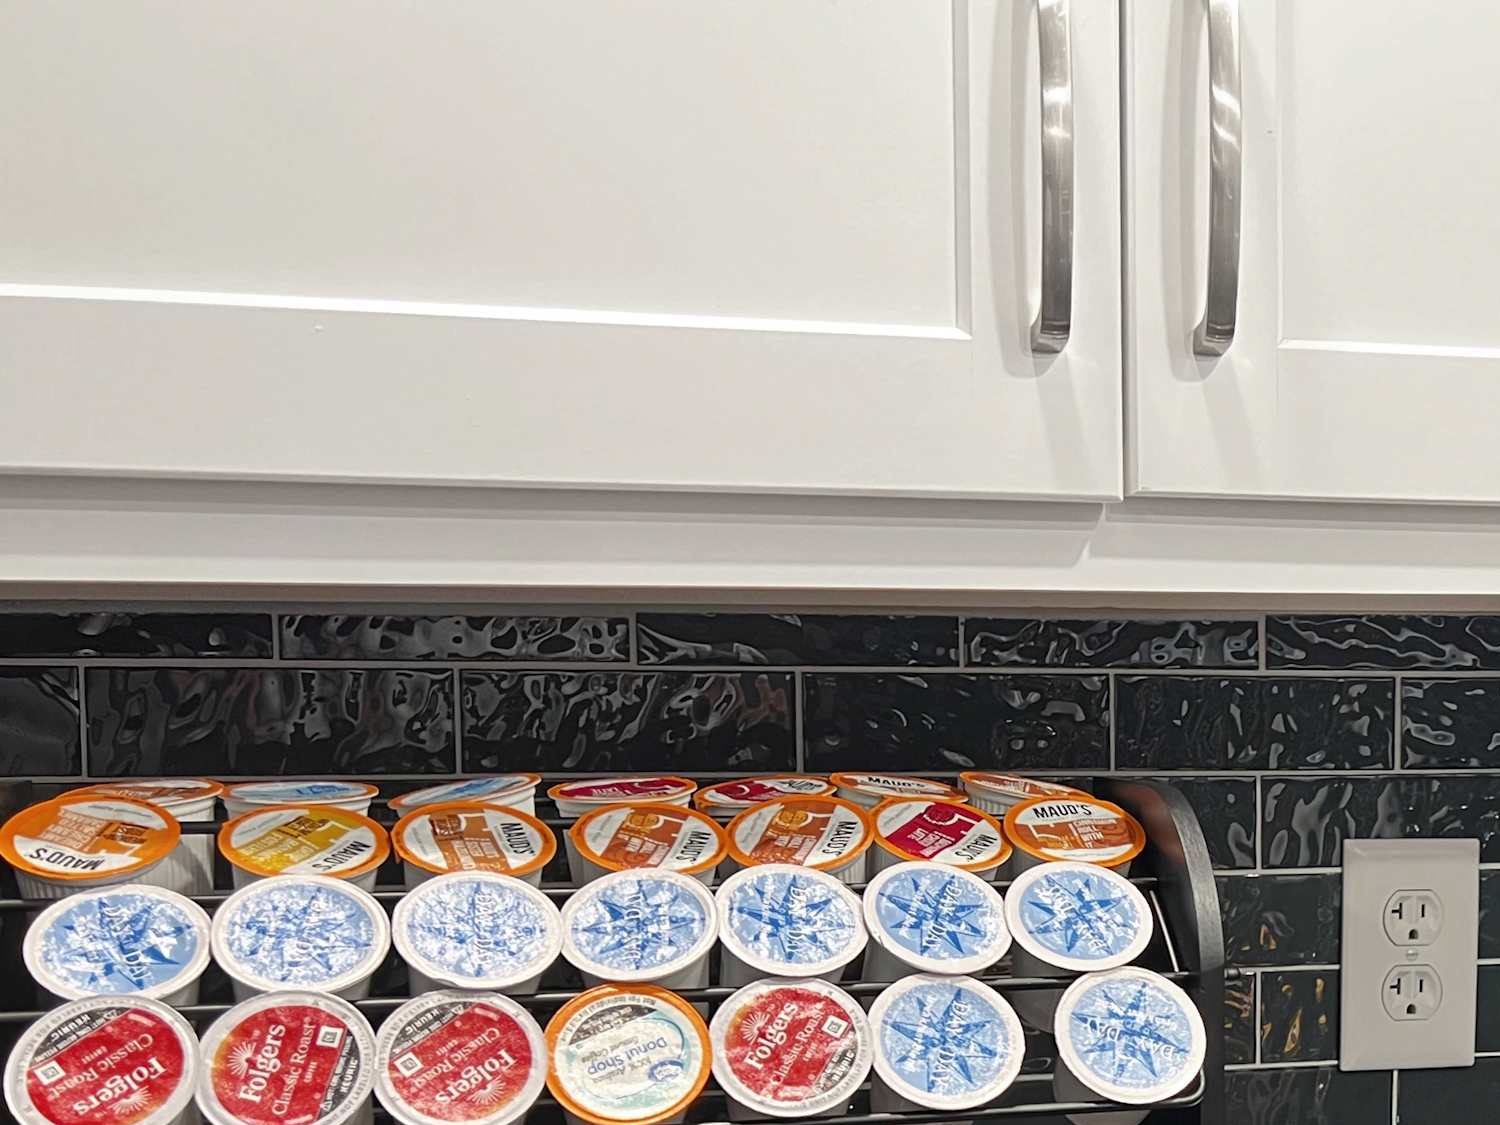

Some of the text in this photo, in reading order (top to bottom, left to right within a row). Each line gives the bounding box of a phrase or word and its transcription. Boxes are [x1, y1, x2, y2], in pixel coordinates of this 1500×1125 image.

[1032, 804, 1092, 819] MAUD'S
[312, 841, 371, 871] MAUD'S
[500, 822, 537, 856] MAUD'S
[676, 830, 712, 864] MAUD'S
[822, 821, 857, 857] MAUD'S
[30, 848, 104, 871] MAUD'S
[97, 1033, 154, 1072] Classic
[451, 1027, 501, 1062] Classic
[744, 1002, 799, 1070] Folgers
[238, 1024, 286, 1104] Folgers
[271, 1022, 317, 1116] Classic Roast
[413, 1058, 456, 1088] Roast
[586, 1036, 668, 1076] Donut Shop
[771, 1043, 804, 1087] Classic
[49, 1067, 99, 1100] Roast
[73, 1056, 168, 1116] Folgers
[435, 1048, 518, 1105] Folgers
